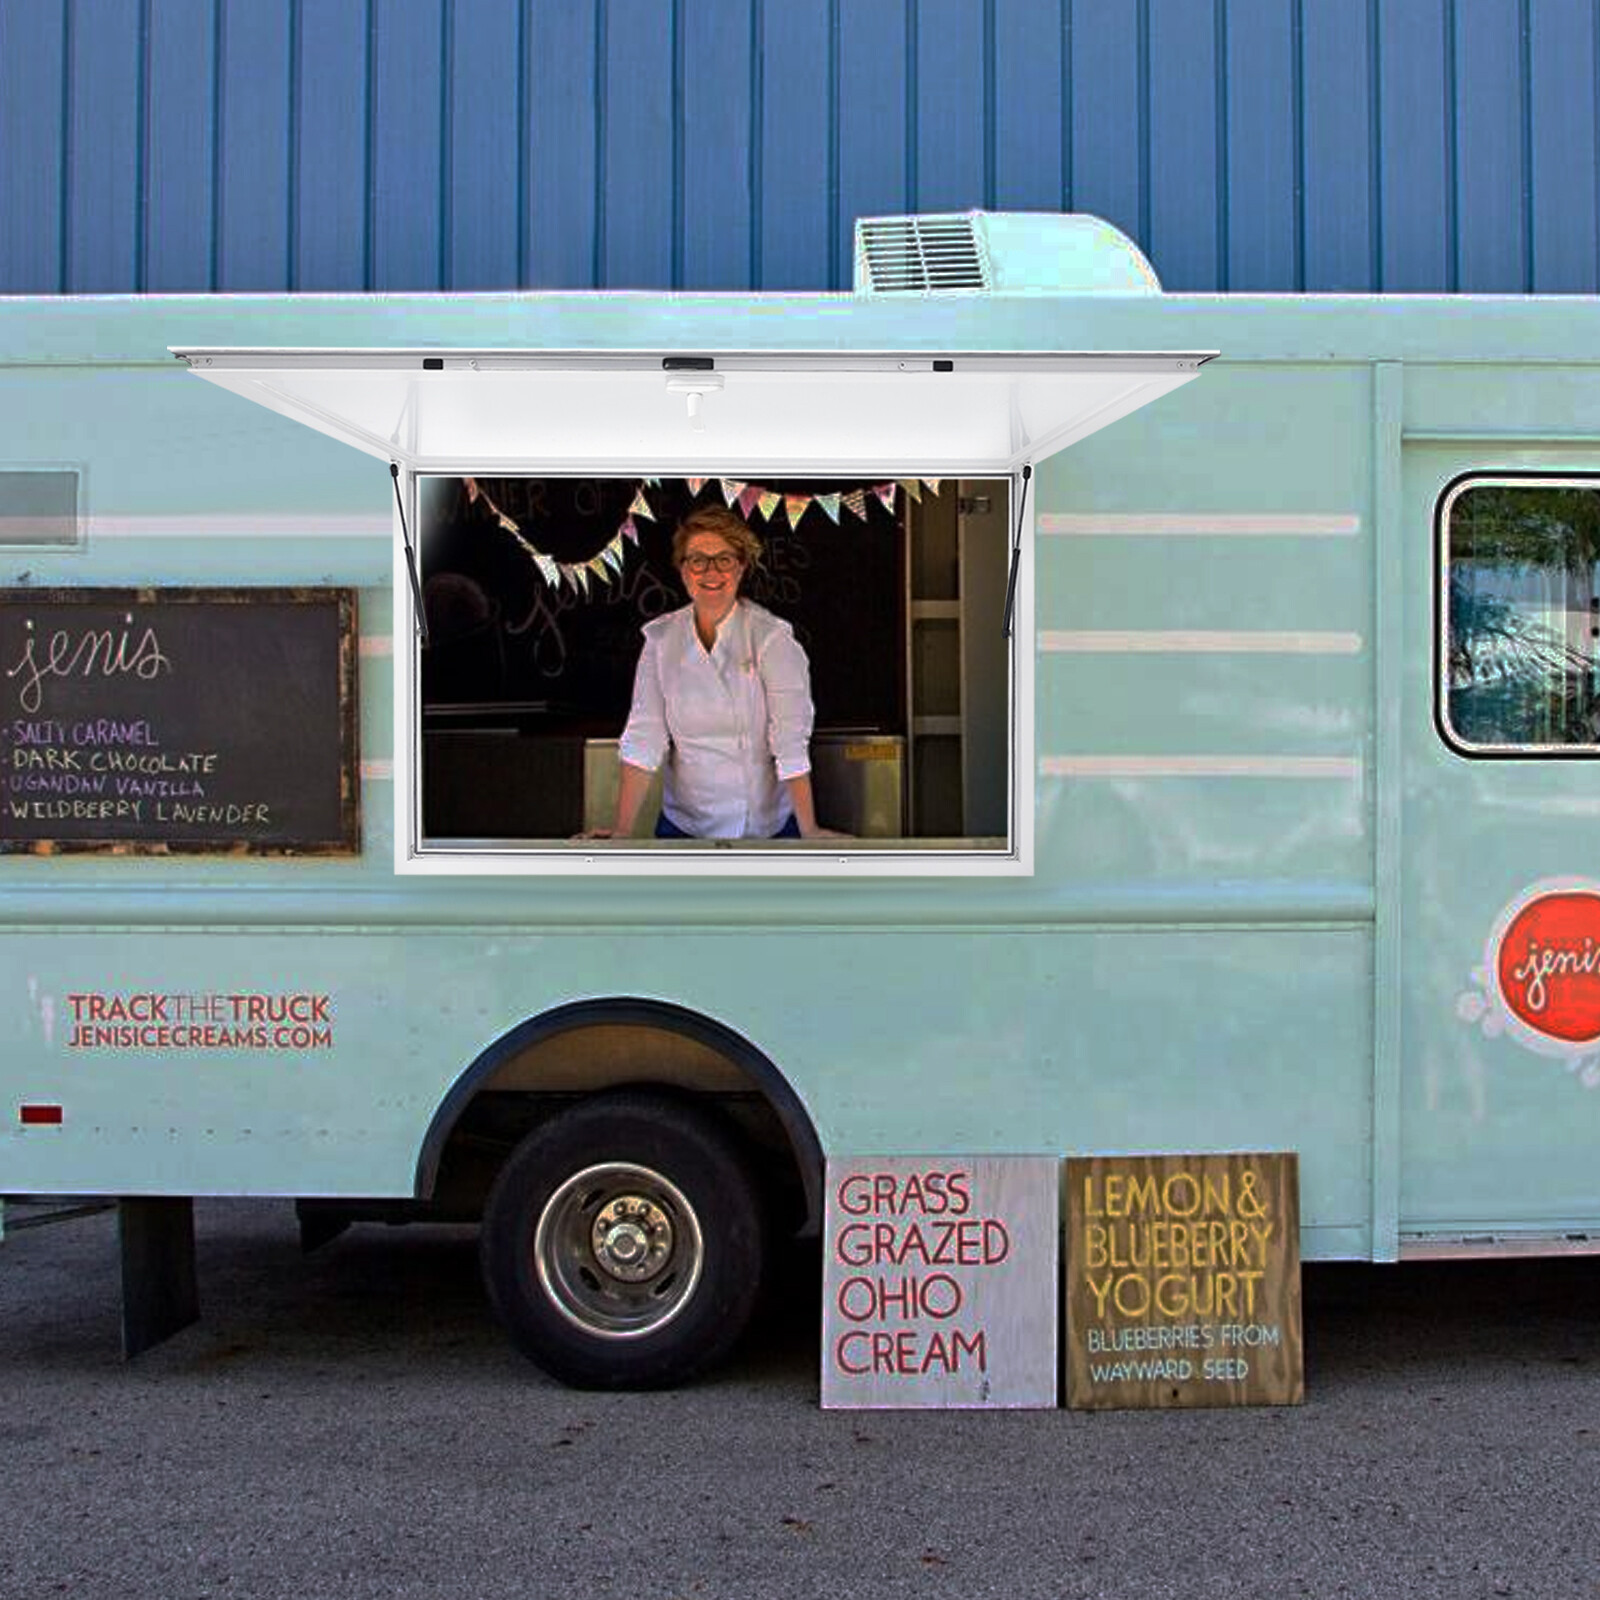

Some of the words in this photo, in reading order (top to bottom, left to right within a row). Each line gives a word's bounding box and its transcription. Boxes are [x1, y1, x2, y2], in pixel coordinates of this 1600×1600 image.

[7, 613, 171, 713] jenis
[14, 720, 65, 746] SALTY
[73, 719, 159, 747] CARAMEL
[14, 749, 81, 771] DARK
[91, 753, 217, 776] CHOCOLATE
[10, 774, 107, 795] UGANDAN
[116, 778, 205, 798] VANILLA
[10, 800, 142, 822] WILDBERRY
[157, 803, 271, 825] LAVENDER
[69, 1026, 332, 1049] JENISICECREAMS.COM
[838, 1172, 970, 1215] GRASS
[838, 1220, 1009, 1266] GRAZED
[1086, 1221, 1274, 1268] BLUEBERRY
[838, 1273, 963, 1322] OHIO
[1086, 1270, 1265, 1318] YOGURT
[837, 1330, 987, 1374] CREAM
[1088, 1325, 1214, 1353] BLUEBERRIES
[1221, 1323, 1280, 1347] FROM
[1090, 1359, 1192, 1383] WAYWARD
[1203, 1357, 1249, 1380] SEED
